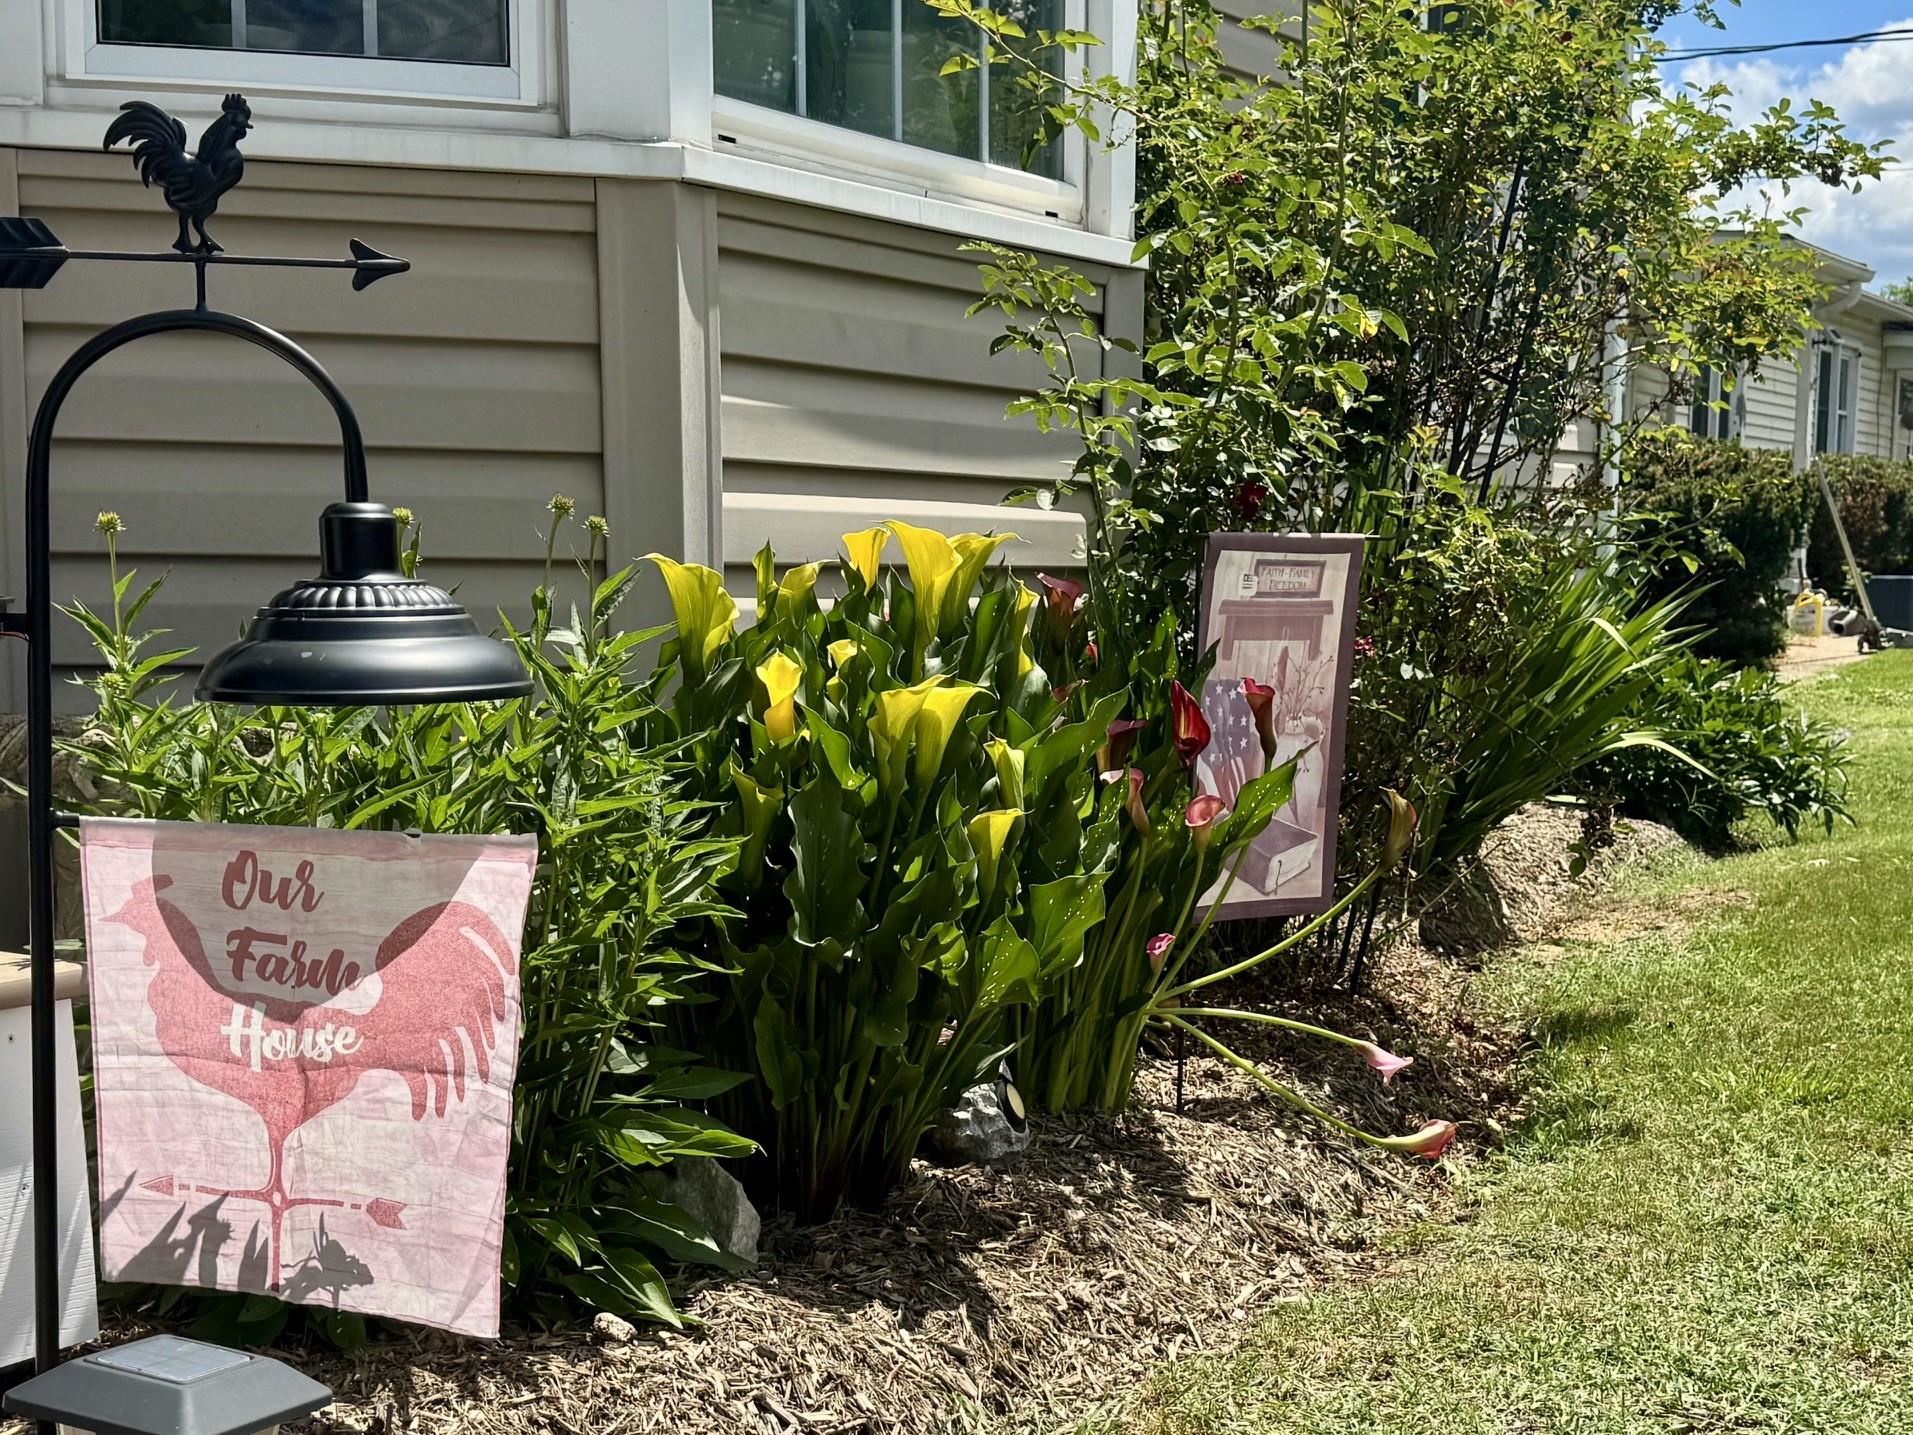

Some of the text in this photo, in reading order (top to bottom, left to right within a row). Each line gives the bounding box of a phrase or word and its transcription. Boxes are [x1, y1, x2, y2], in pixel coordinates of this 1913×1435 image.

[222, 850, 324, 912] Our
[226, 926, 363, 997] Farm
[220, 1001, 364, 1072] House
